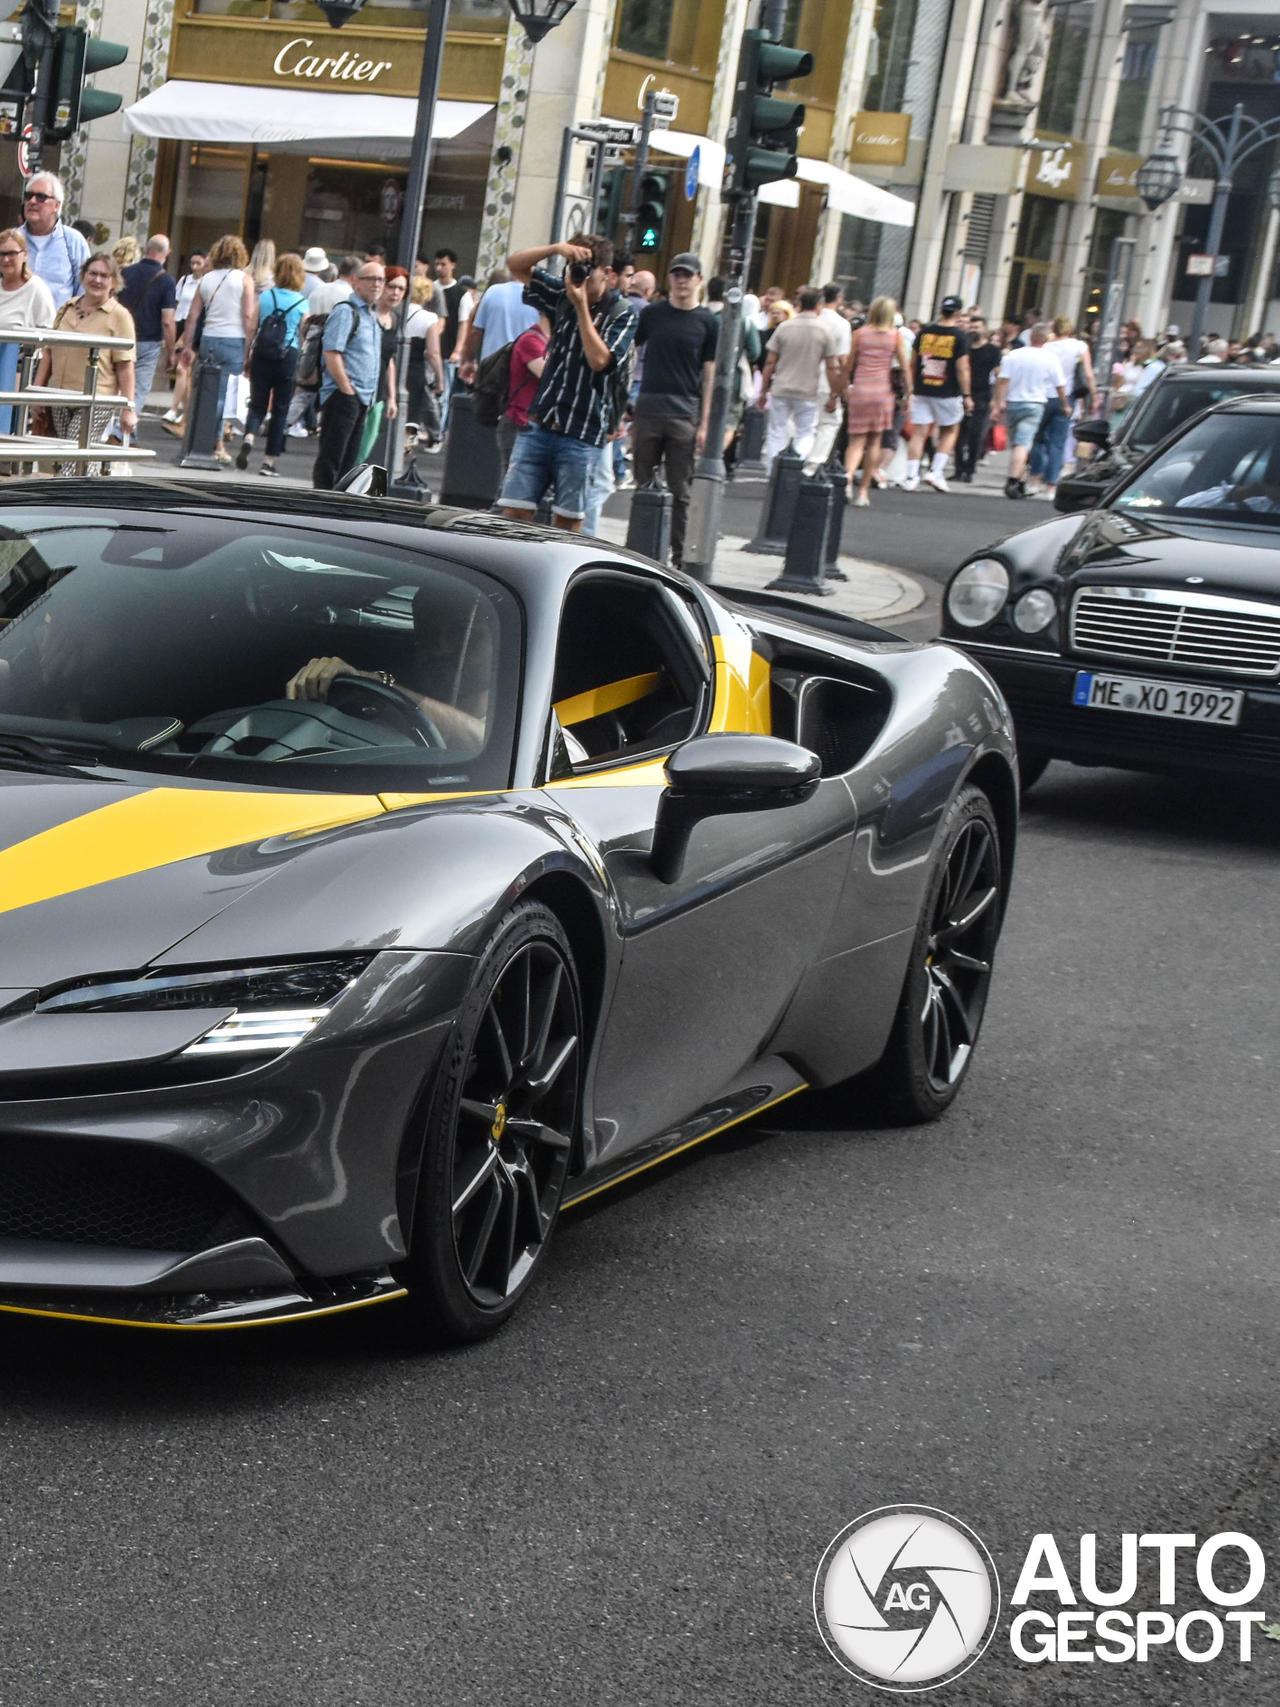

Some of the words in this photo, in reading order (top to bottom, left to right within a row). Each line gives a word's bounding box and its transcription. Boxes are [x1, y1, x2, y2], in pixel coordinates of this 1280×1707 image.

[273, 38, 392, 82] Cartier
[251, 122, 312, 141] Cartier
[1091, 679, 1122, 706] ME
[1137, 685, 1168, 712] XO
[1173, 690, 1234, 720] 1992
[435, 1077, 457, 1173] MICHELIN
